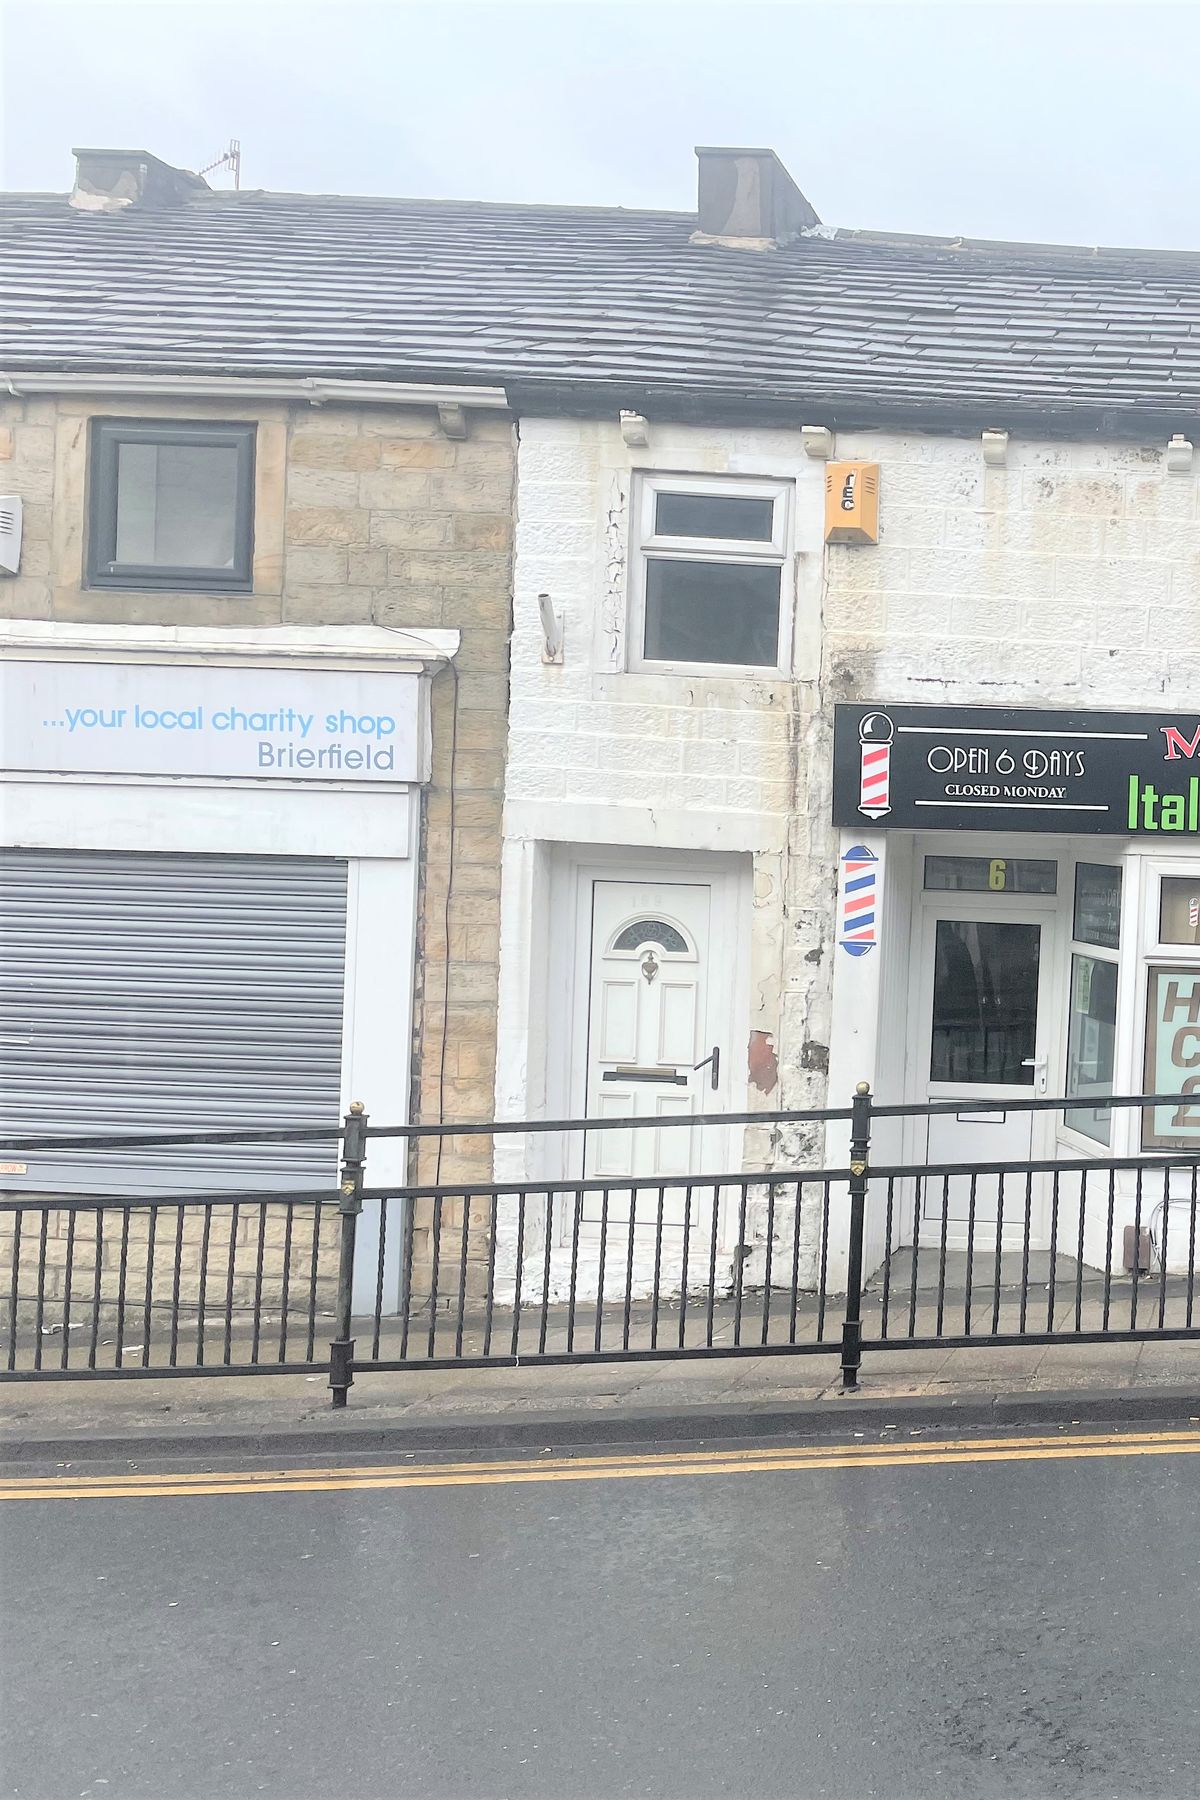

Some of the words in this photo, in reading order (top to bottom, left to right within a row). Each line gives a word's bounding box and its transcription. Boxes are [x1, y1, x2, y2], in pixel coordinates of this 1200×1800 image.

[134, 704, 203, 731] local
[211, 706, 315, 738] charity
[325, 709, 396, 740] shop
[257, 741, 395, 771] Brierfield
[927, 745, 990, 774] OPEN
[995, 749, 1016, 775] 6
[1022, 749, 1085, 779] DAYS
[944, 784, 1001, 798] CLOSED
[1003, 786, 1067, 799] MONDAY
[988, 859, 1008, 891] 6
